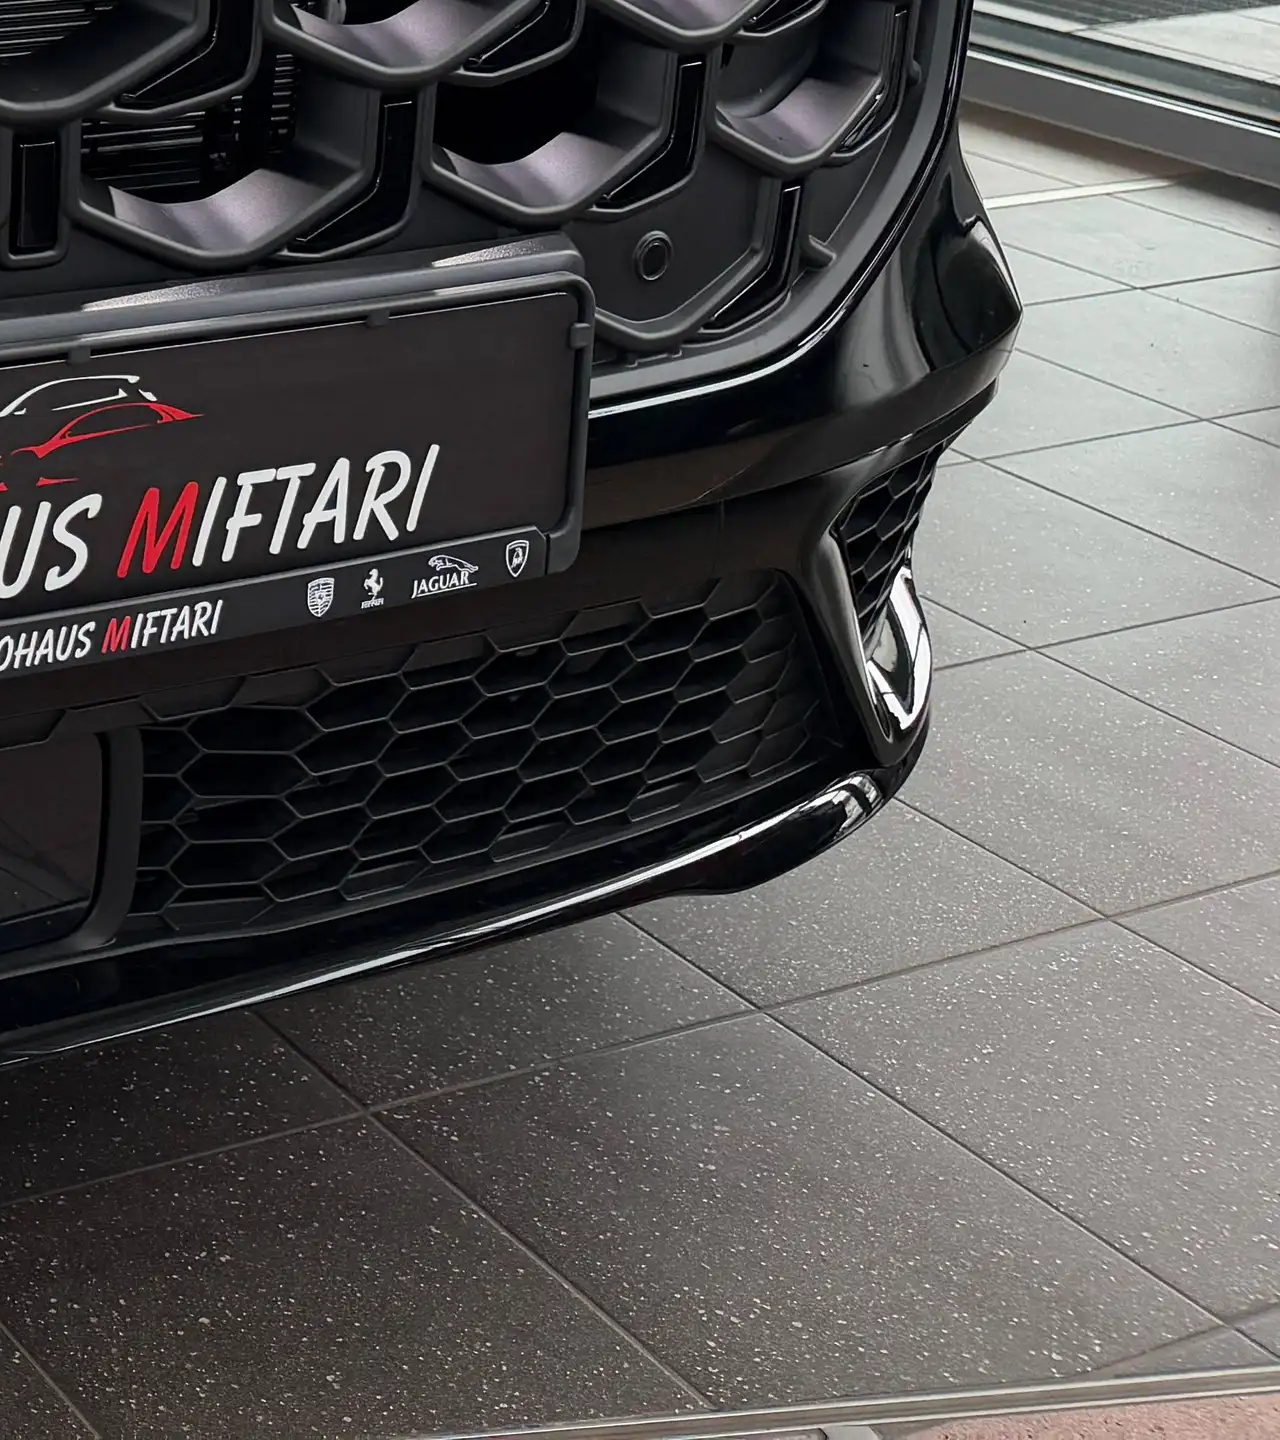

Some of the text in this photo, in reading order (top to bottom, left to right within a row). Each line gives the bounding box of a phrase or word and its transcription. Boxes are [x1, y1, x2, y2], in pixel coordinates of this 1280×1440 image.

[117, 444, 441, 579] MIFTARI
[410, 570, 470, 599] JAGUAR
[102, 599, 222, 654] MIFTARI
